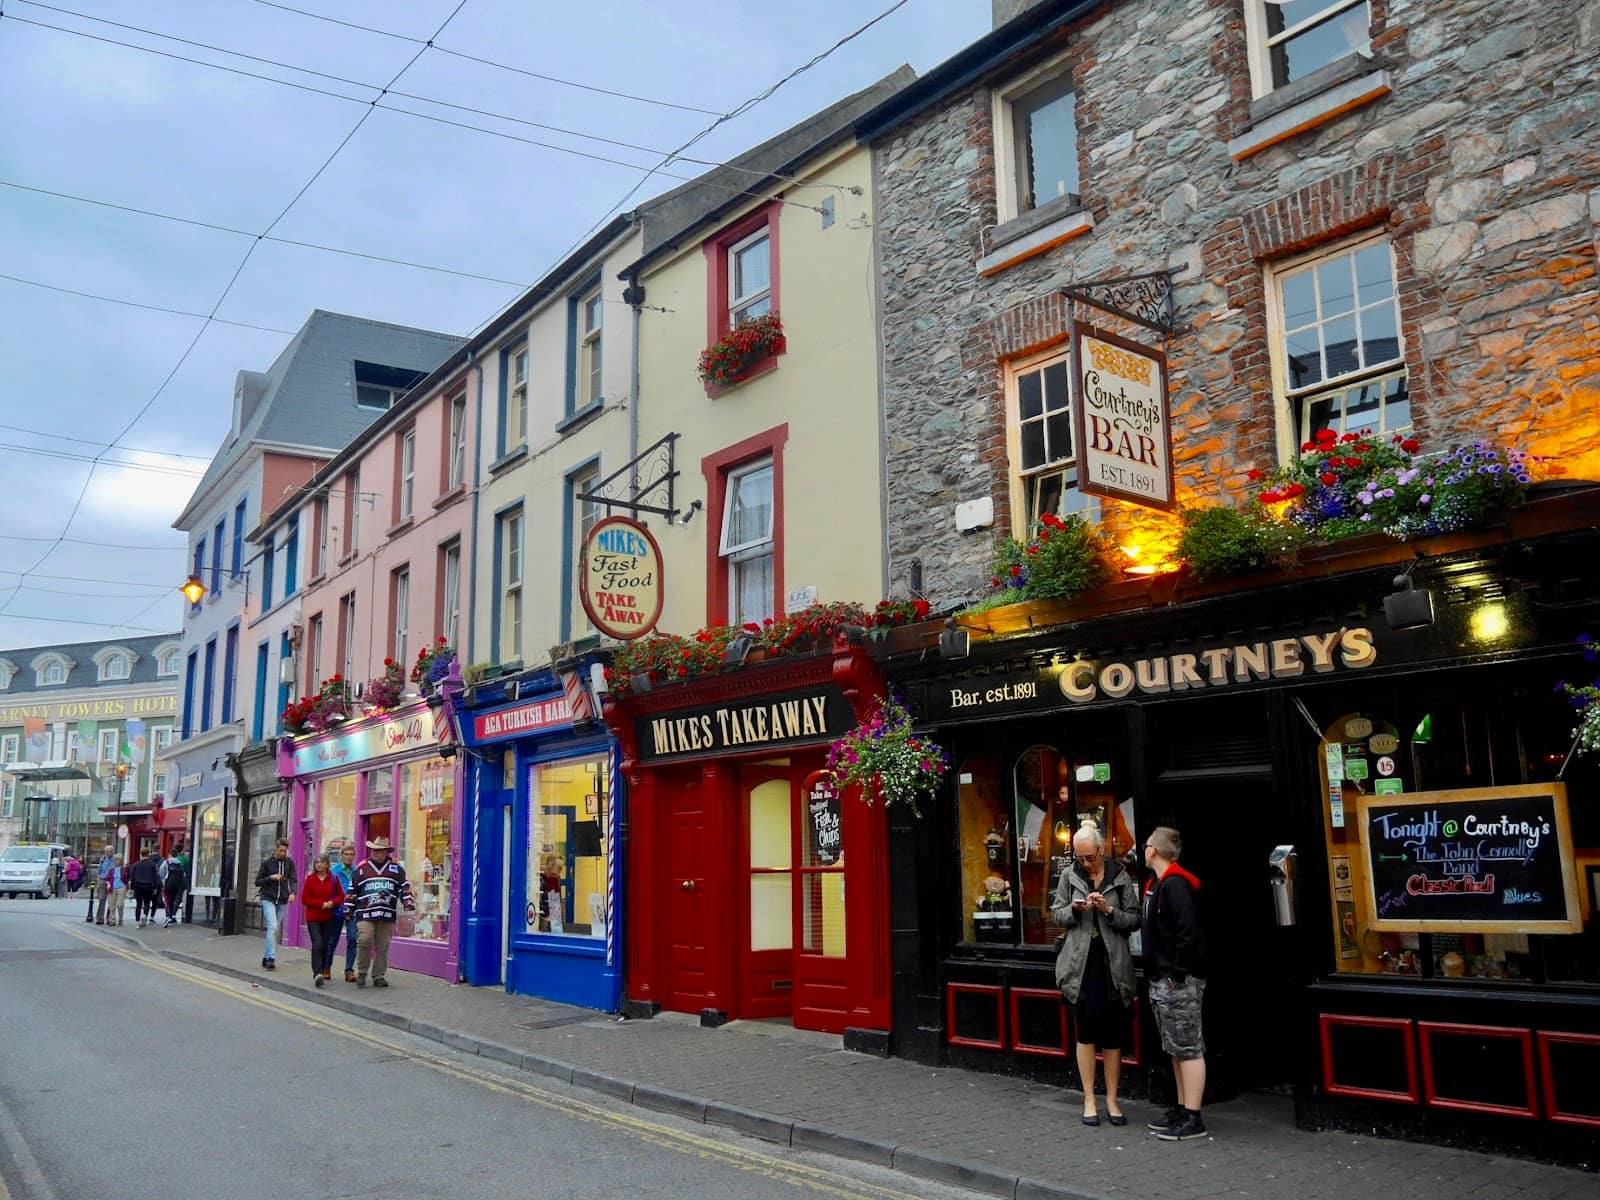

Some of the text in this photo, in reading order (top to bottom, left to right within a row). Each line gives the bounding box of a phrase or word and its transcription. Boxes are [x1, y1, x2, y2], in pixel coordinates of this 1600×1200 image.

[1084, 370, 1160, 436] Courtney's
[1088, 413, 1159, 469] BAR
[598, 529, 647, 557] MIKE'S
[592, 554, 639, 573] Fast
[600, 572, 653, 591] Food
[595, 592, 637, 608] TAKE
[602, 605, 645, 624] AWAY
[58, 700, 125, 719] TOWERS
[485, 716, 501, 734] AGA
[502, 706, 542, 730] TURKISH
[651, 695, 827, 755] MIKES TAKEAWAY
[1379, 760, 1394, 773] 15
[819, 827, 840, 847] Chips
[1373, 810, 1442, 847] Tonight
[1463, 814, 1551, 848] Courtney's
[1413, 846, 1437, 861] The
[1406, 873, 1460, 895] Classic
[1502, 887, 1543, 905] Blues
